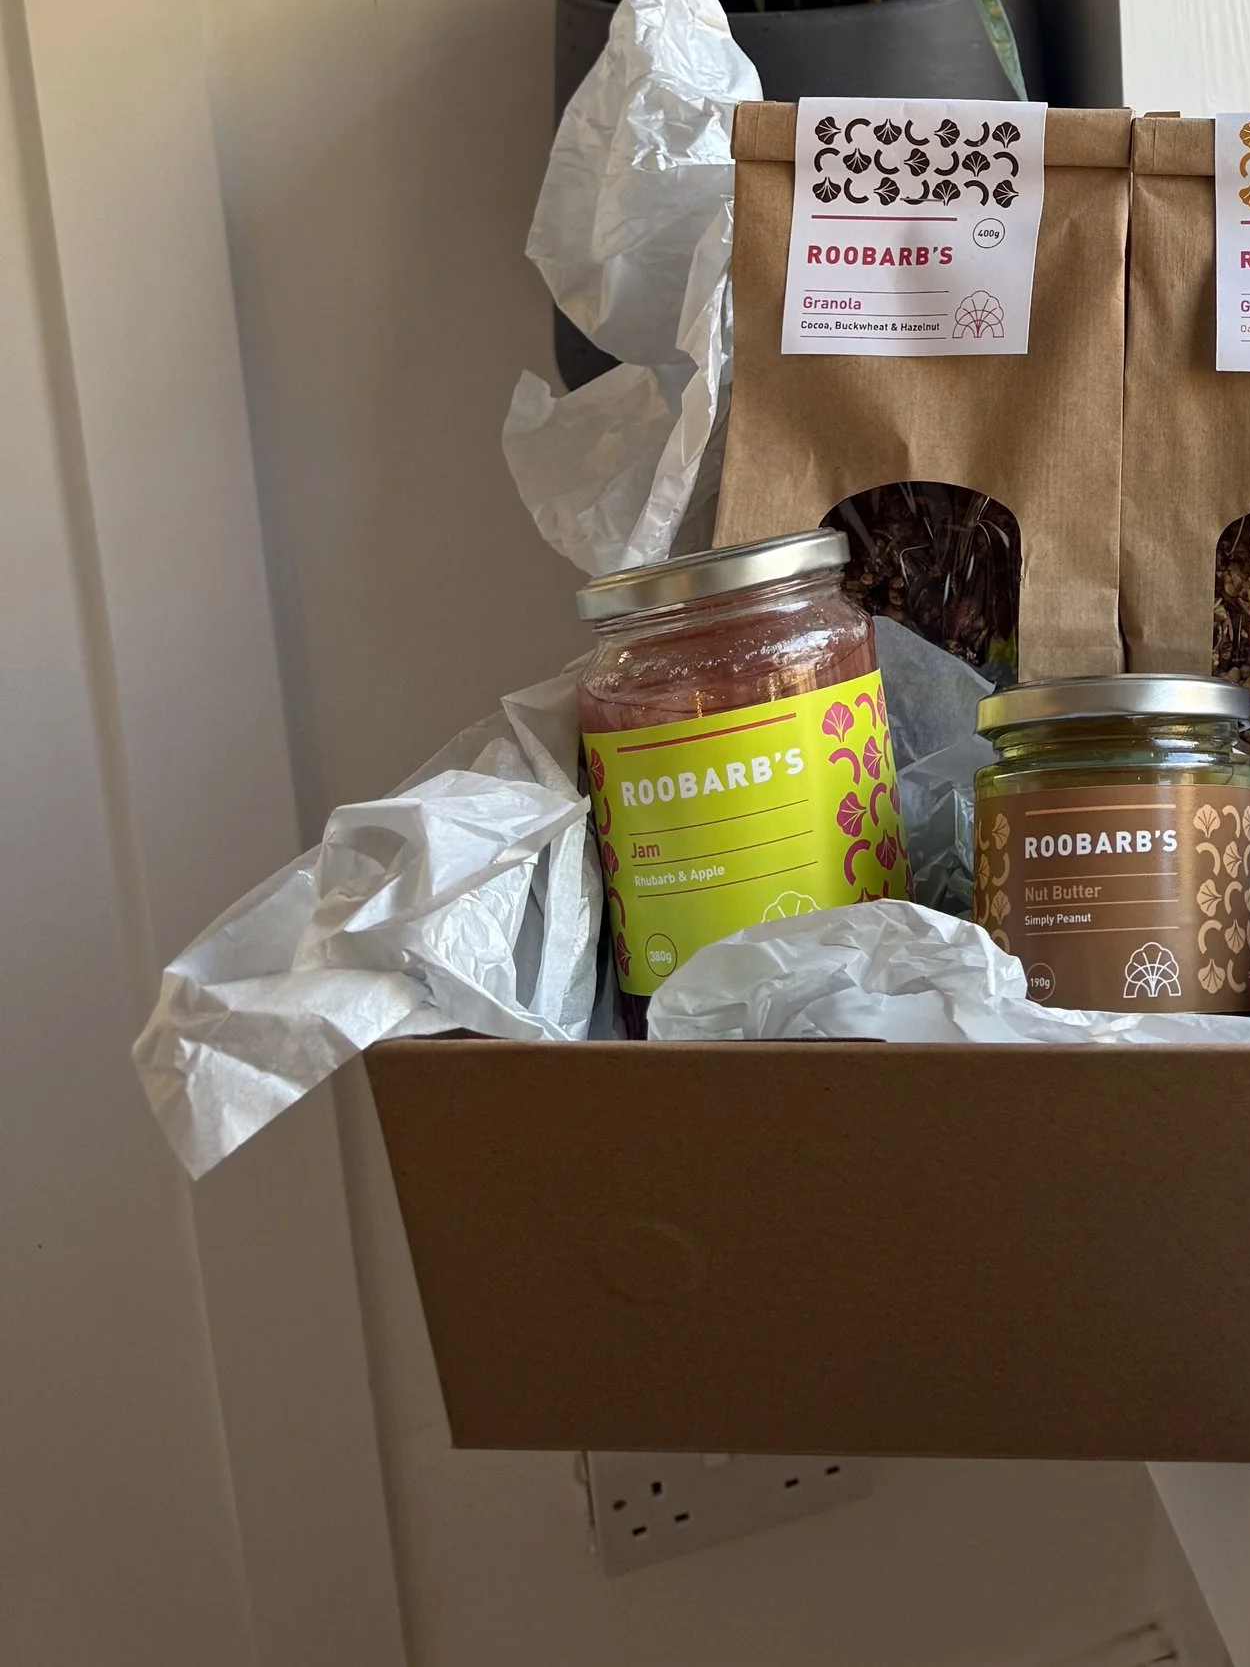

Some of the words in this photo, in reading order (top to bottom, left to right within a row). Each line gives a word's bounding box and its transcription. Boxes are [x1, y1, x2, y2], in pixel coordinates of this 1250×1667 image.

[977, 228, 1000, 239] 400g
[807, 245, 953, 266] ROOBARB'S
[803, 297, 861, 310] Granola
[800, 320, 832, 331] Cocoa,
[835, 321, 888, 332] Buckwheat
[891, 323, 898, 332] &
[900, 322, 940, 332] Hazelnut
[620, 747, 805, 807] ROOBARB'S
[630, 842, 661, 860] Jam
[1025, 829, 1178, 859] ROOBARB'S
[634, 871, 676, 888] Rhubarb
[678, 870, 688, 882] &
[690, 865, 725, 883] Apple
[1025, 887, 1049, 903] Nut
[1053, 885, 1102, 902] Butter
[1024, 914, 1055, 927] Simply
[1056, 912, 1092, 924] Peanut
[649, 950, 672, 965] 380g
[1030, 976, 1050, 990] 190g
